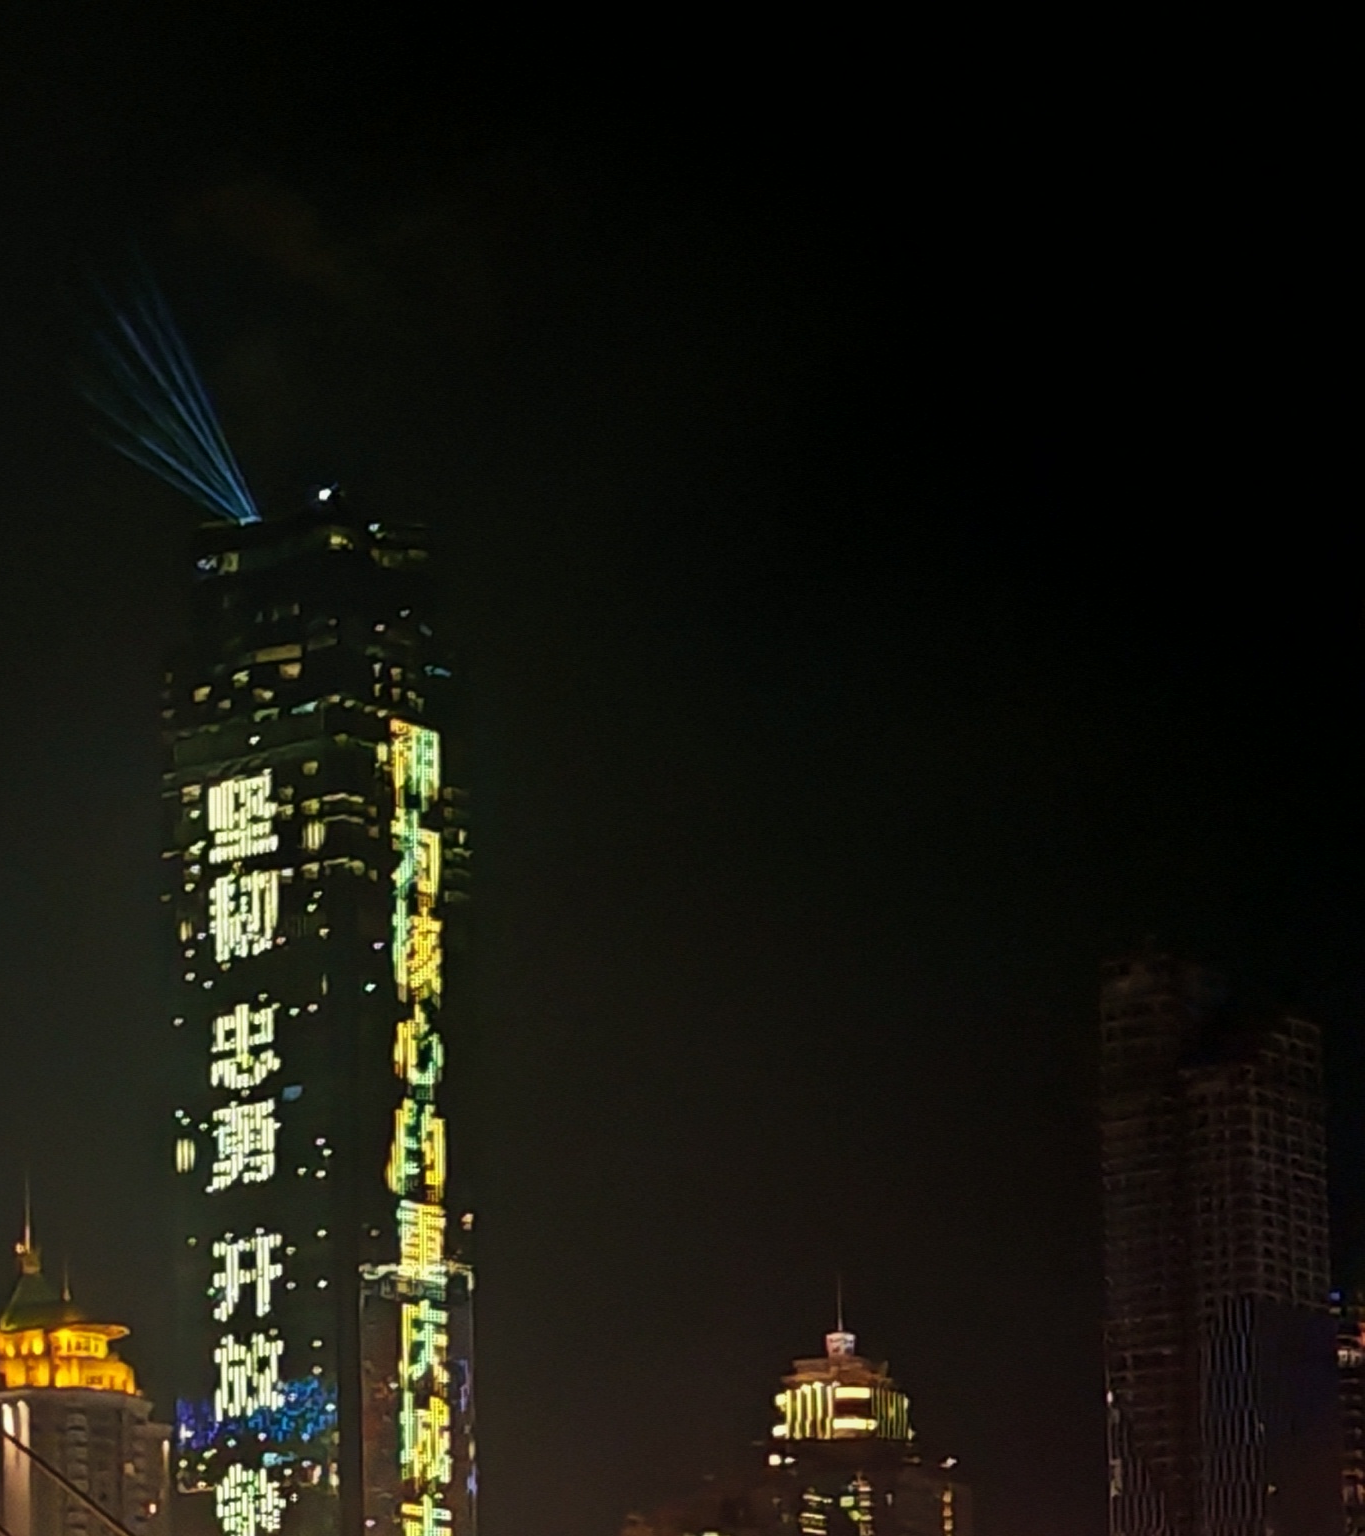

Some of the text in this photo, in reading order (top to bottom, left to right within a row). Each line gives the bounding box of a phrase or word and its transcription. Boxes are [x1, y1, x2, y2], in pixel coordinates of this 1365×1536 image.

[207, 768, 279, 962] 坚韧
[207, 1002, 281, 1192] 忠勇
[211, 1228, 285, 1422] 开放
